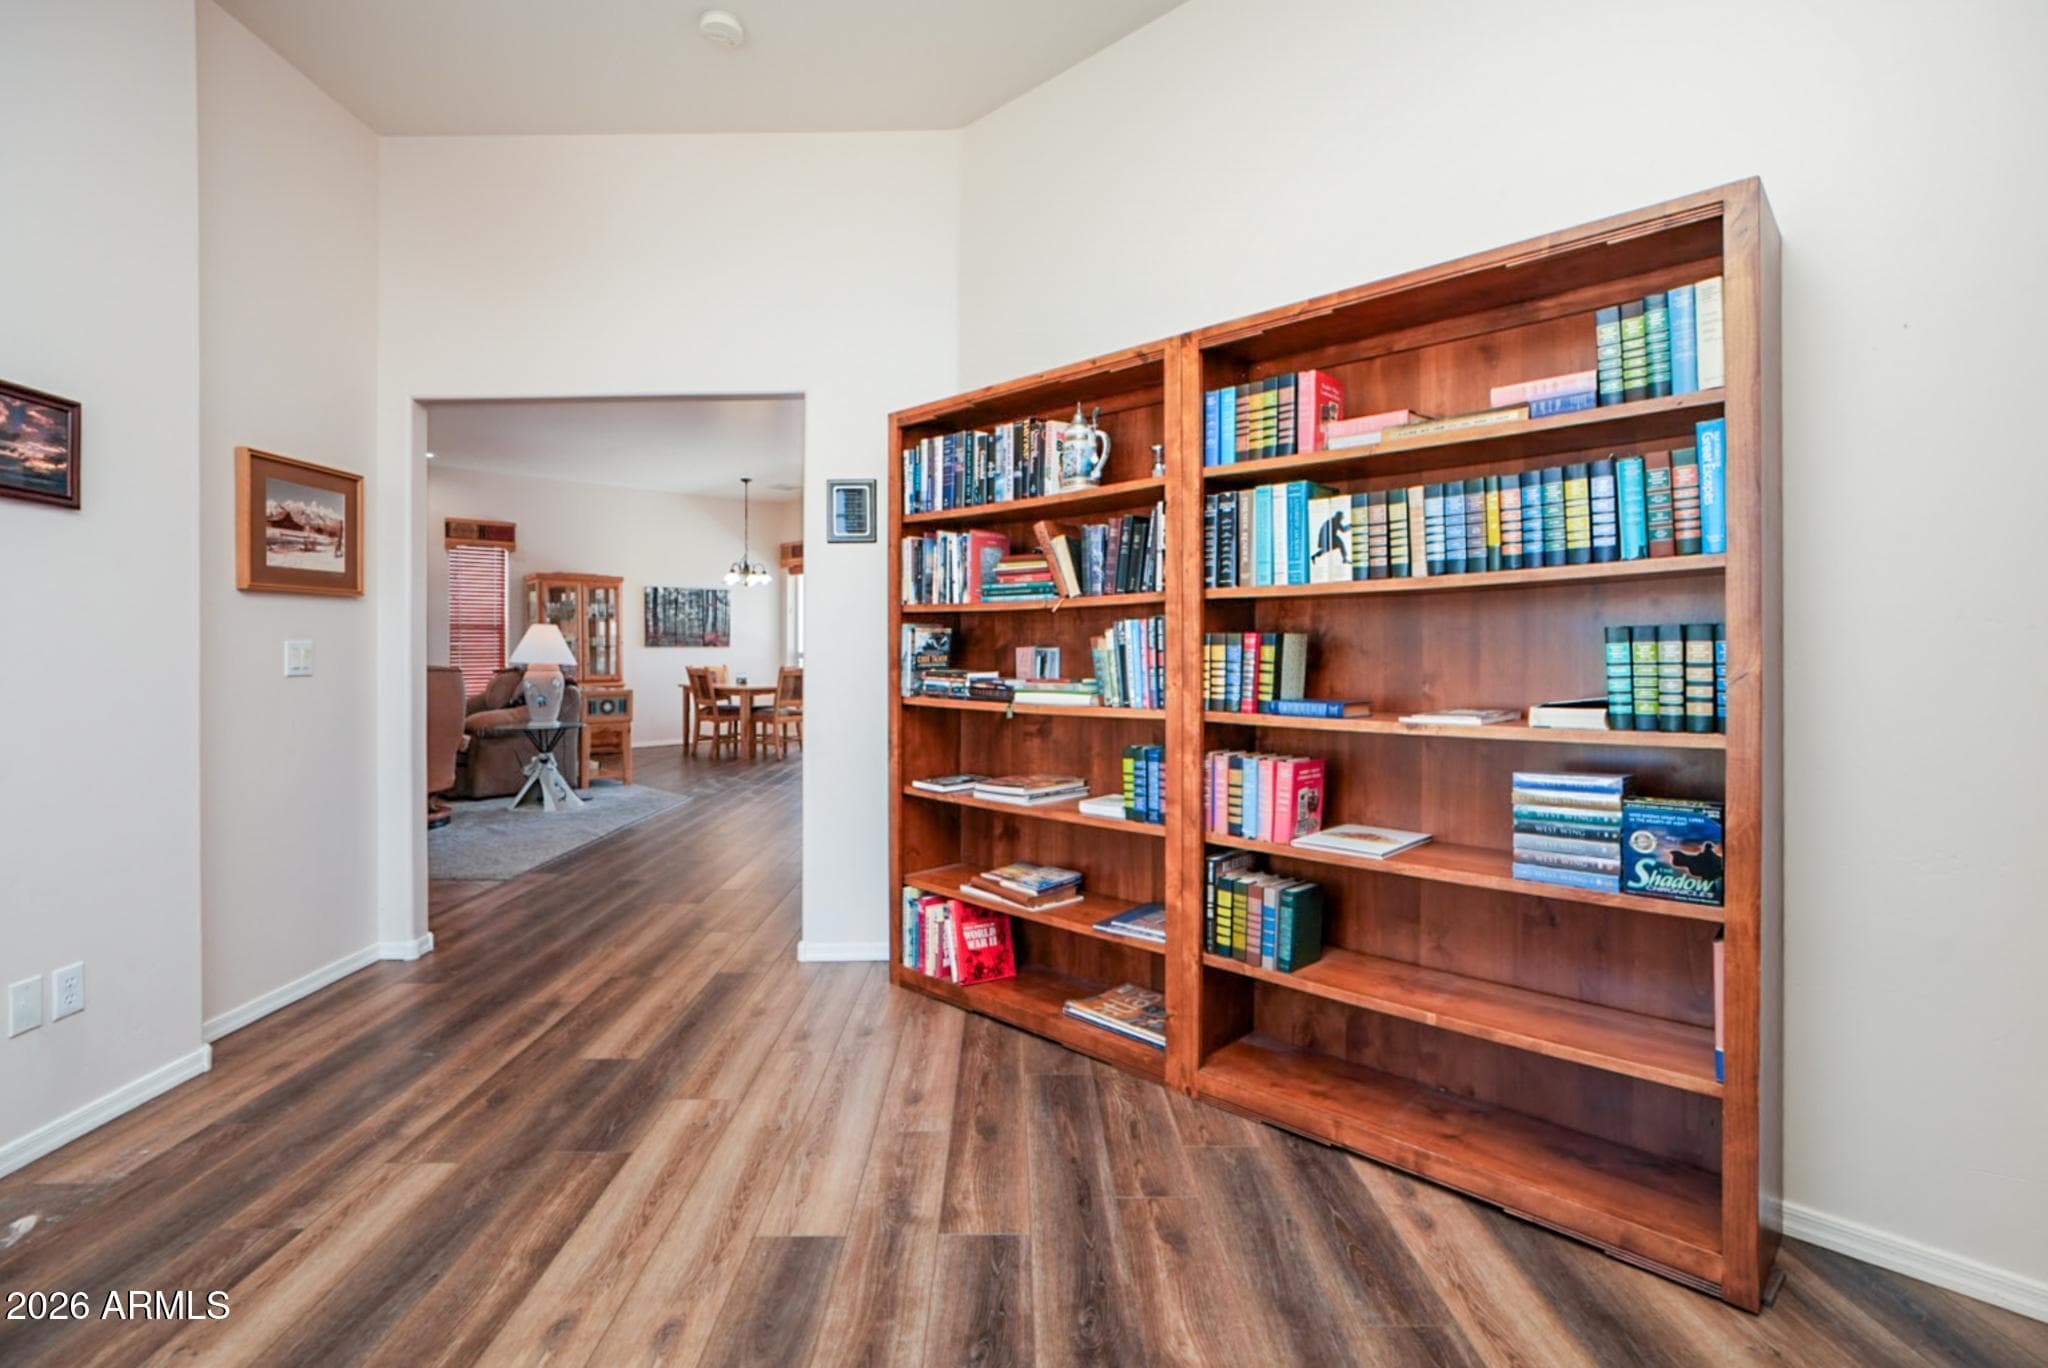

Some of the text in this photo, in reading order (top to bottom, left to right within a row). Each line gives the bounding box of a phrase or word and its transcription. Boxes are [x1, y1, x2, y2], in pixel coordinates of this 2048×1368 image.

[1627, 858, 1715, 892] Shadow
[963, 927, 997, 941] WORLD
[967, 937, 988, 951] WAR
